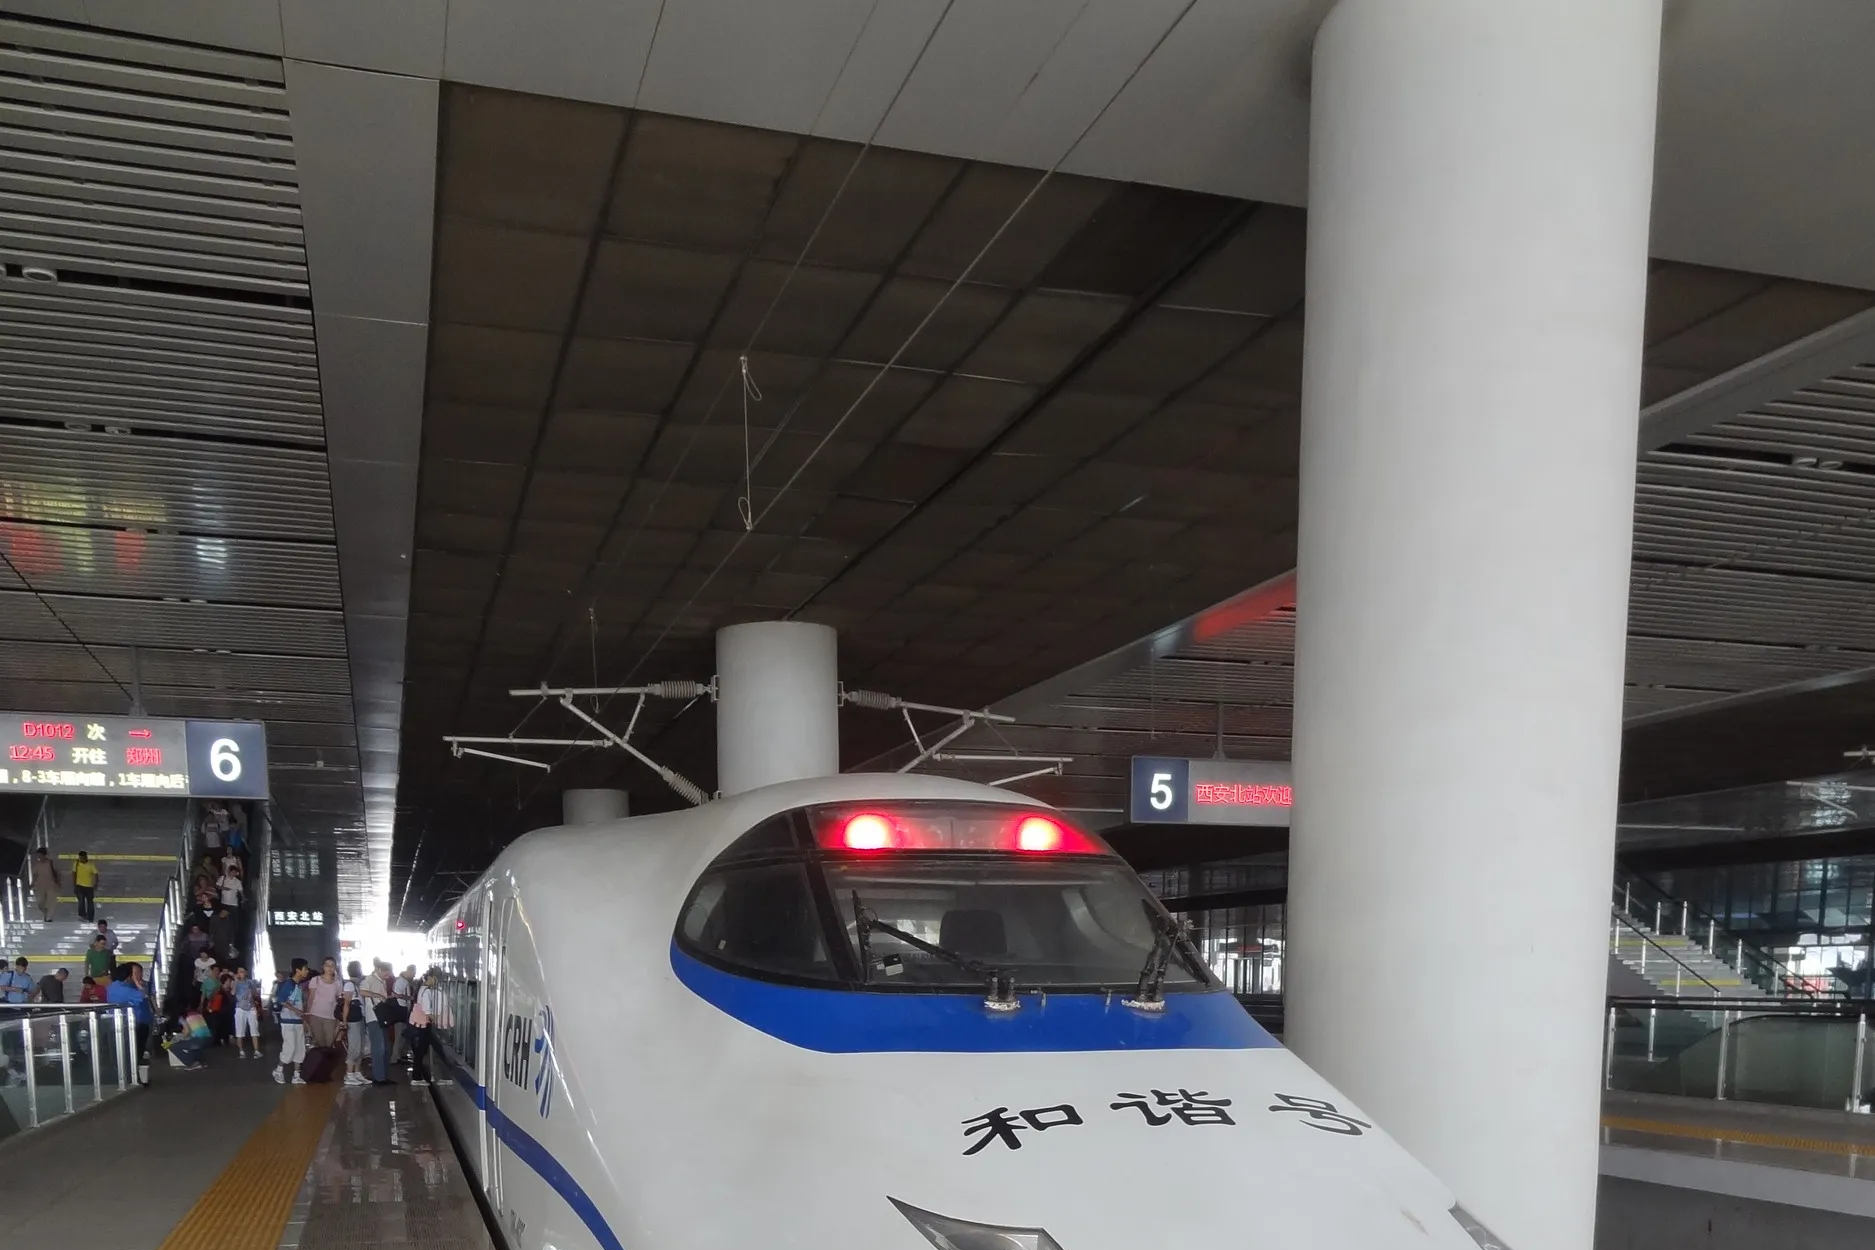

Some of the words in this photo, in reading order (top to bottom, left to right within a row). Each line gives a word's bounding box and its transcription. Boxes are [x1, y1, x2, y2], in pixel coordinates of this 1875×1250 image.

[23, 722, 75, 739] D1012
[87, 723, 107, 741] 次
[10, 745, 55, 761] 12:45
[210, 738, 242, 782] 6
[1150, 773, 1173, 810] 5
[1196, 783, 1292, 805] 西安北站欢迎
[273, 910, 323, 921] 西安北站
[503, 1012, 533, 1091] CRH
[961, 1087, 1373, 1157] 和谐号
